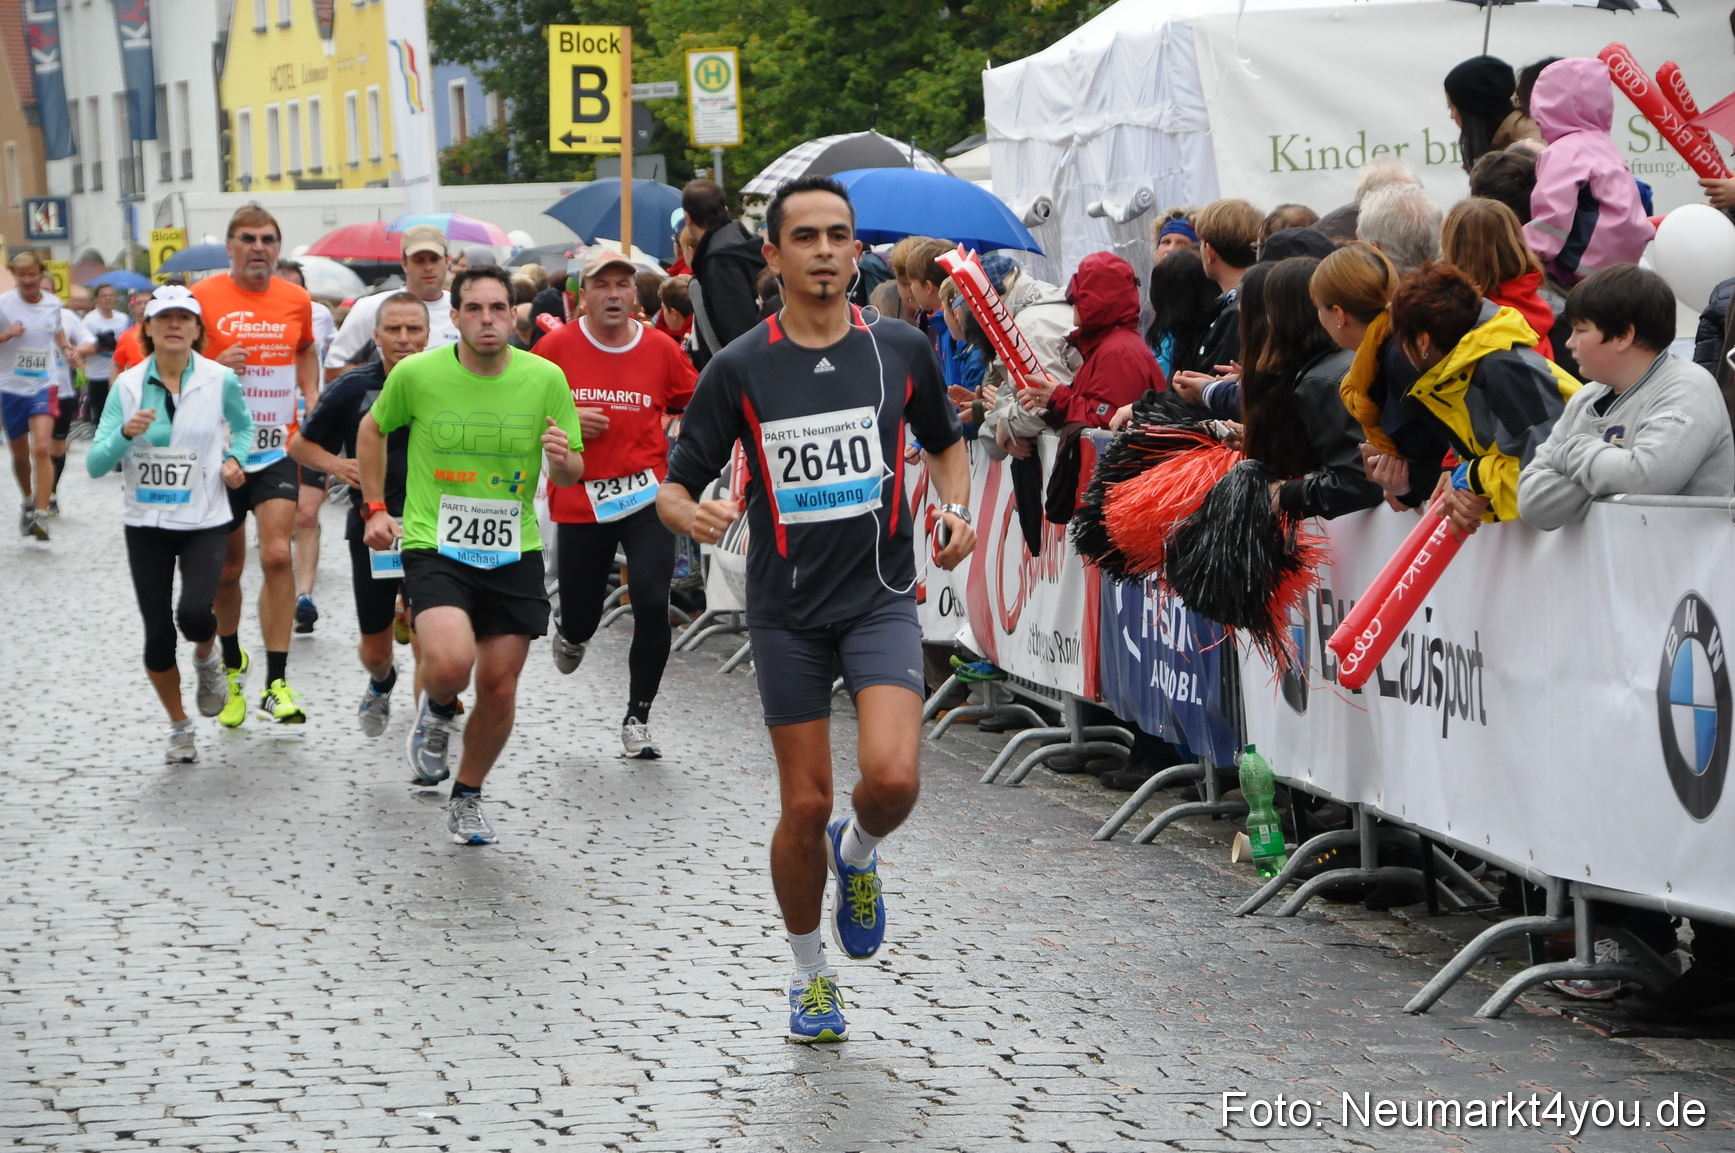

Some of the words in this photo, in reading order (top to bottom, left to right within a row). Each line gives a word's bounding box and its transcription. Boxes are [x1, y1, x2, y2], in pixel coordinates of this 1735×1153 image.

[560, 31, 622, 54] Block
[269, 63, 297, 93] HOTEL
[572, 64, 611, 124] B
[1654, 105, 1694, 147] BKK
[1269, 130, 1410, 172] Kinder
[152, 230, 183, 241] Block
[230, 320, 287, 332] Fischer
[17, 355, 47, 369] 2644
[813, 365, 835, 373] adidas
[571, 388, 641, 405] NEUMARKT
[764, 428, 801, 443] PARTL
[802, 420, 857, 438] Neumarkt
[778, 434, 872, 484] 2640
[138, 462, 192, 486] 2067
[434, 468, 478, 482] MERZ
[441, 502, 469, 512] PARTL
[471, 506, 508, 515] Neumarkt
[618, 496, 637, 509] Karl
[795, 487, 864, 508] Wolfgang
[446, 514, 513, 547] 2485
[457, 551, 500, 564] Michael
[1391, 549, 1432, 601] BKK
[1665, 599, 1724, 674] BMW
